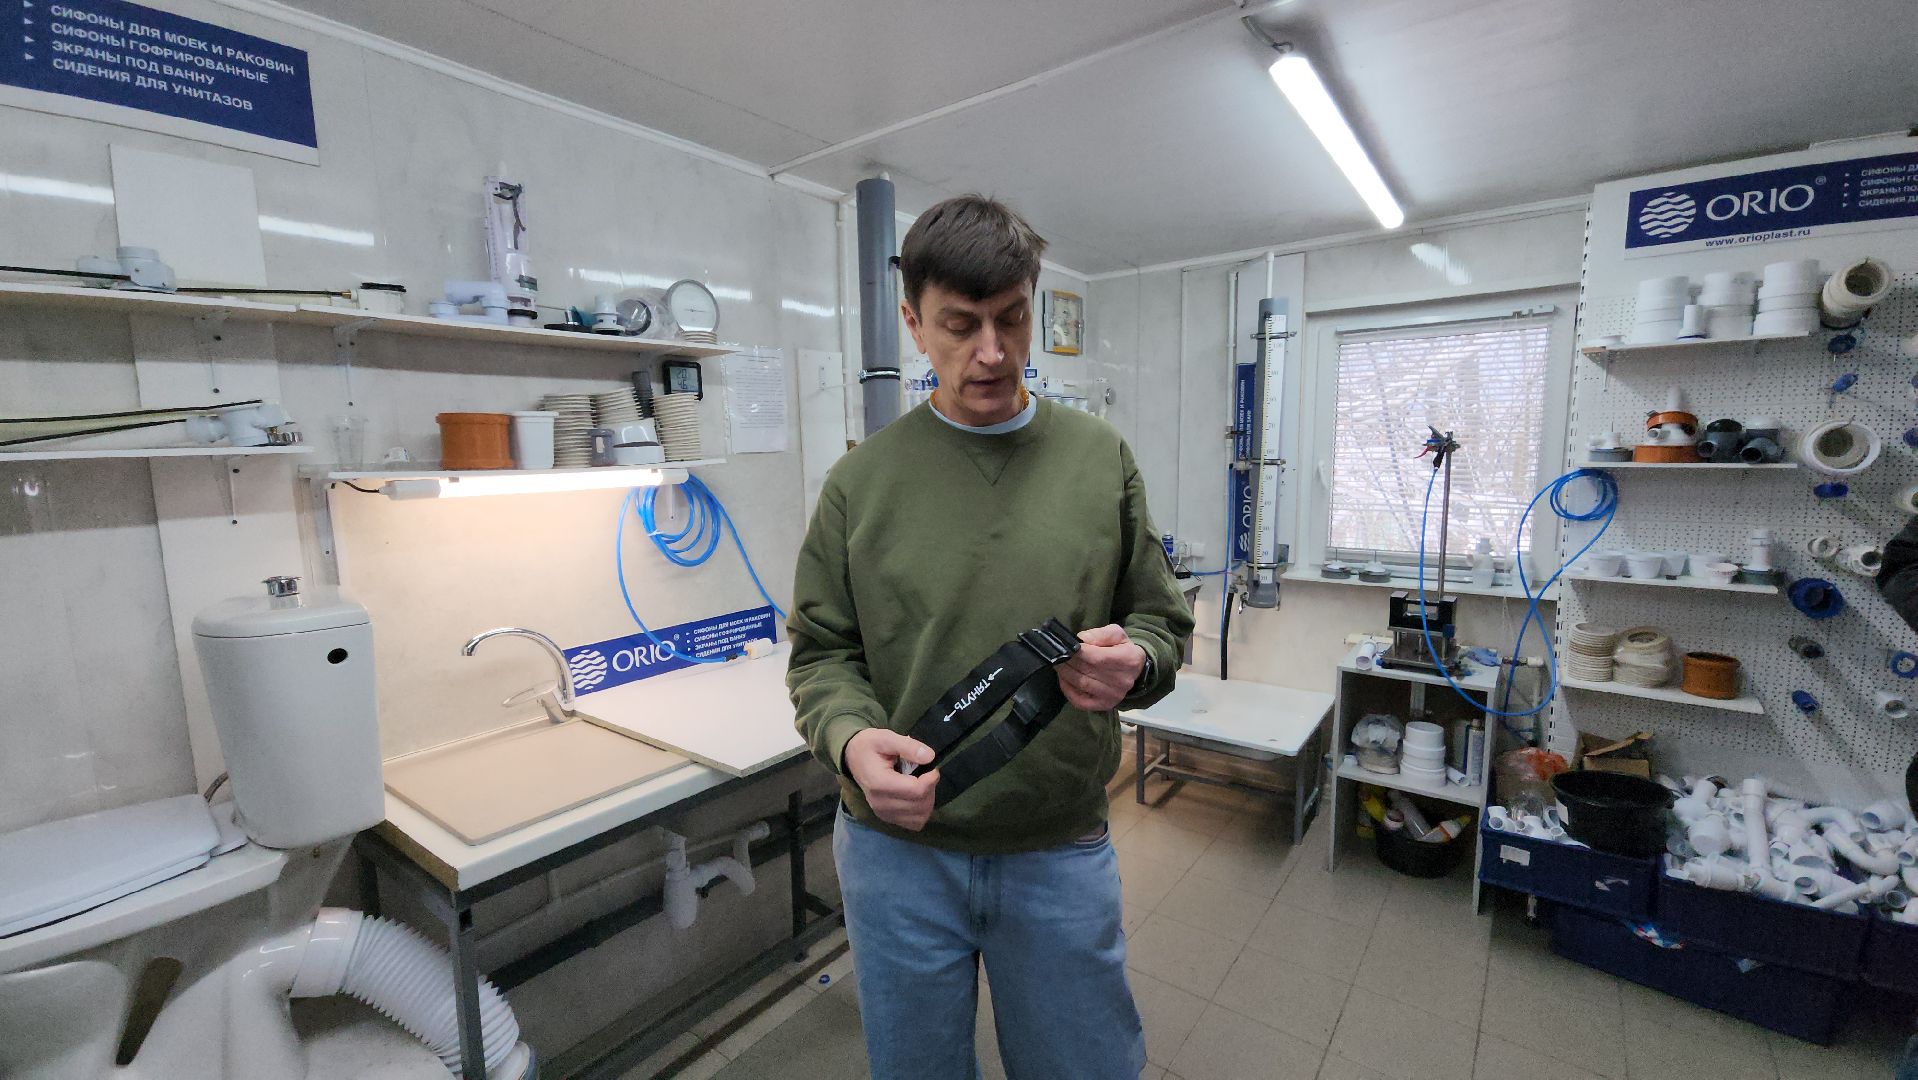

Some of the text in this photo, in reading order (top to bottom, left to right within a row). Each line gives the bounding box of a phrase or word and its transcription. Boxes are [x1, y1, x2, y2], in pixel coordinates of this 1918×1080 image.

[50, 5, 295, 76] СИФОНЫ ДЛЯ МОЕК И РАКОВИН
[51, 22, 269, 84] СИФОНЫ ГОФРИРОВАННЫЕ
[51, 40, 215, 85] ЭКРАНЫ ПОД ВАННУ
[52, 58, 253, 111] СИДЕНИЯ ДЛЯ УНИТАЗОВ
[1705, 184, 1815, 222] ORIO
[1705, 229, 1811, 247] www.orioplast.ru
[612, 640, 676, 672] ORIO
[954, 679, 991, 711] ТЯНУТЬ
